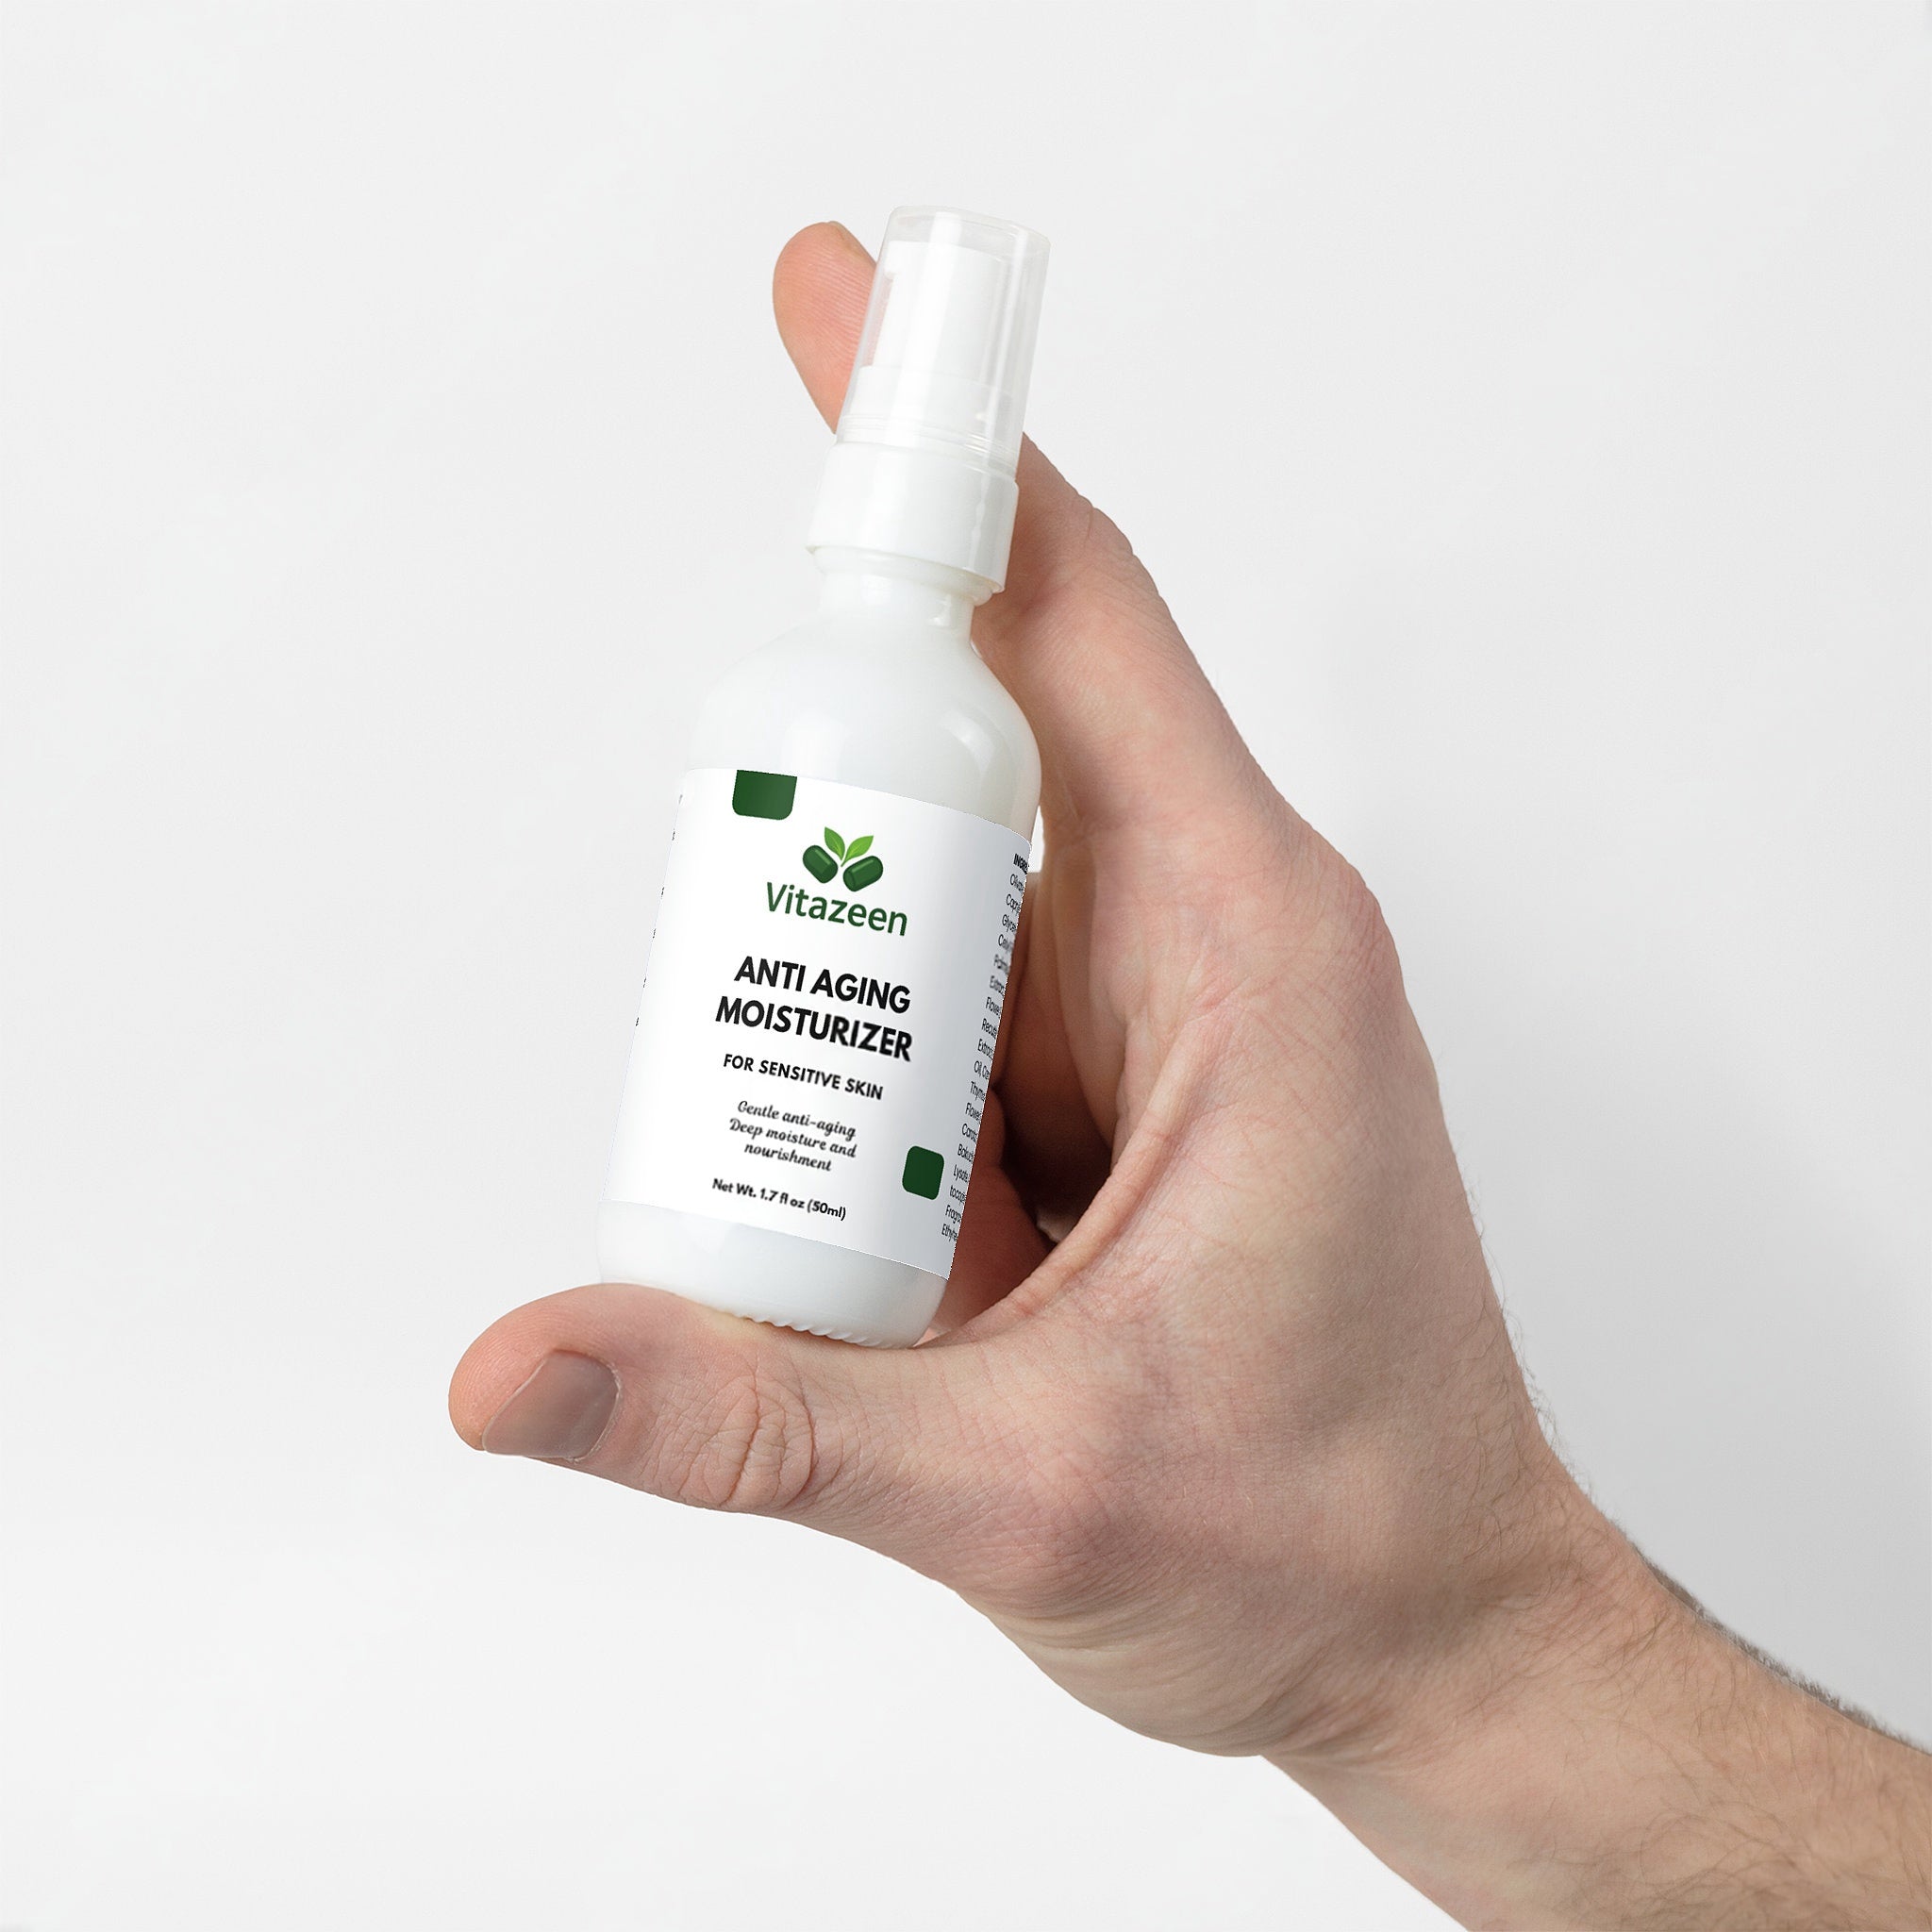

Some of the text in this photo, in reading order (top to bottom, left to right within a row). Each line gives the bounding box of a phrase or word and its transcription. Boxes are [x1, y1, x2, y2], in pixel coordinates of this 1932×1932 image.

[767, 881, 908, 937] Vitazeen
[734, 956, 911, 1014] ANTI AGING
[715, 995, 912, 1062] MOISTURIZER
[723, 1053, 884, 1100] FOR SENSITIVE SKIN
[729, 1118, 858, 1158] Deep moisture and
[737, 1100, 857, 1142] Gentle anti-aging
[744, 1143, 832, 1172] nourishment
[712, 1178, 846, 1221] Net Wt. 1.7 fl oz (50ml)
